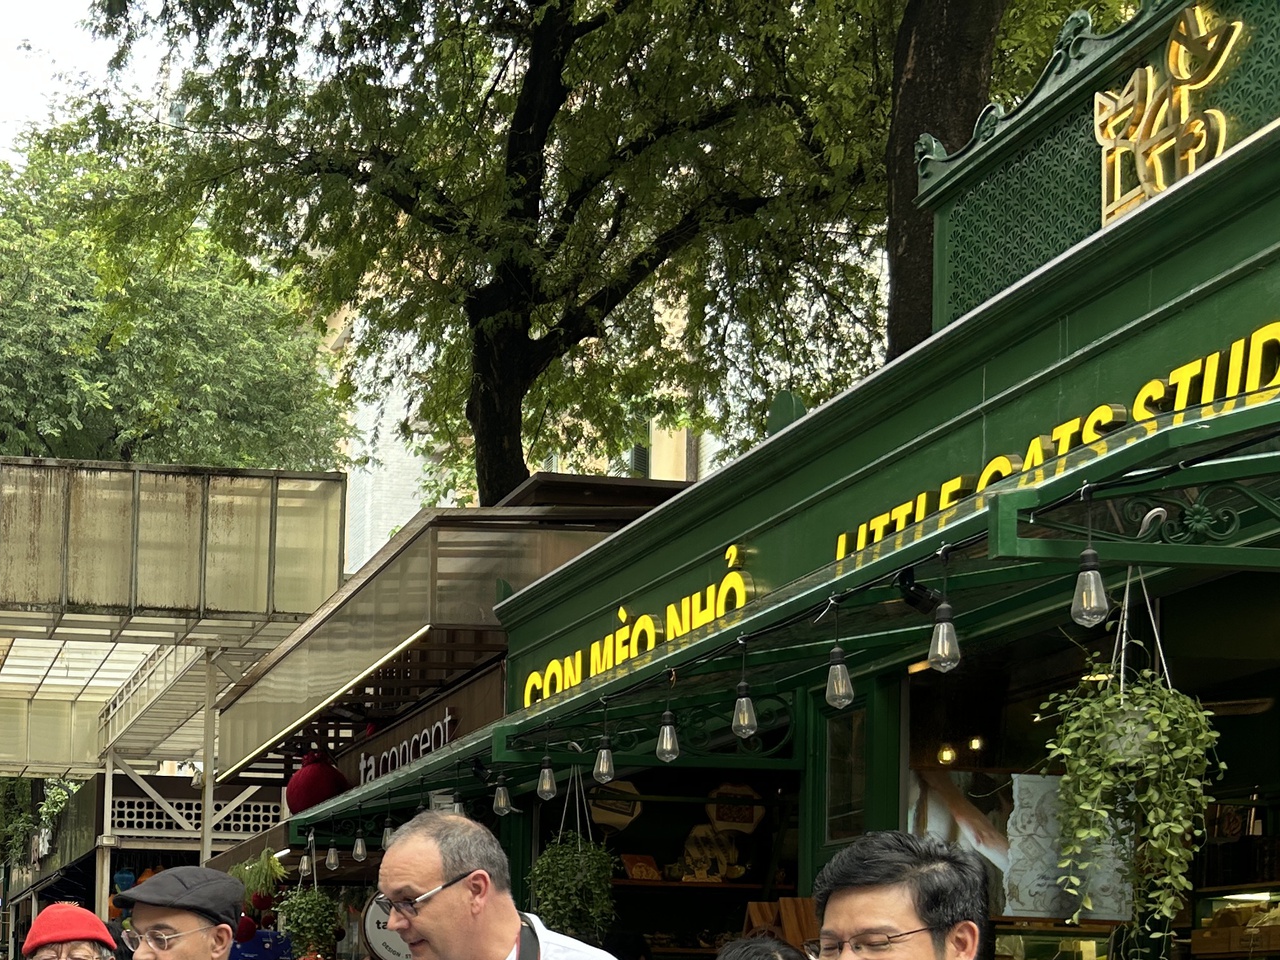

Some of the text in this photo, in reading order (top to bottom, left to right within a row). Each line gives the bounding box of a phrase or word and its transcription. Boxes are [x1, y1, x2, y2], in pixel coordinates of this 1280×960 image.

[835, 477, 962, 576] LITTLE
[524, 544, 746, 708] CON MÈO NHỎ
